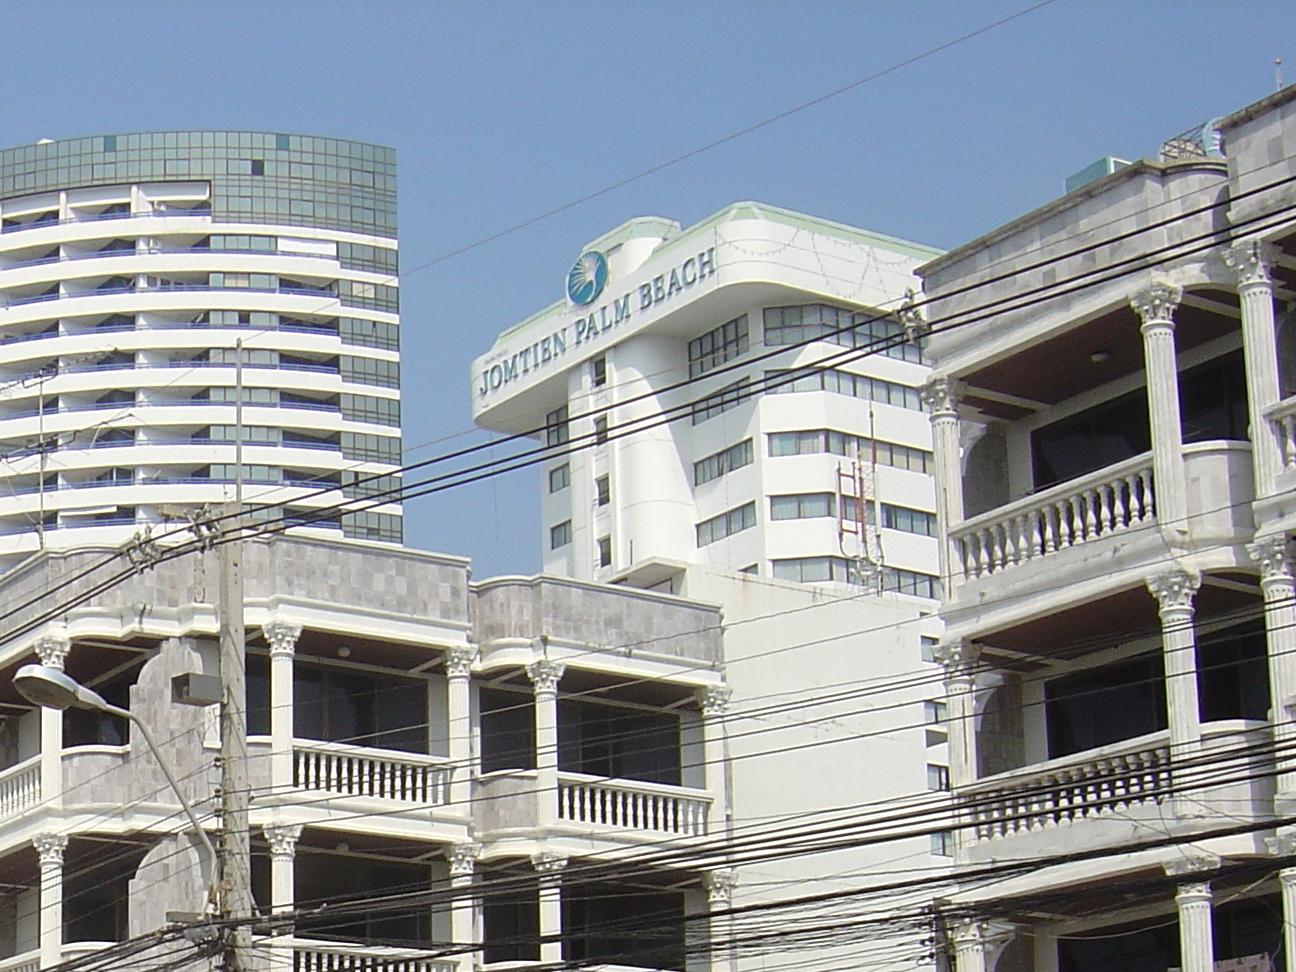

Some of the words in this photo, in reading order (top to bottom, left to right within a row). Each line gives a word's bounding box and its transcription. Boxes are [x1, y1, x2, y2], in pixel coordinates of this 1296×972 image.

[479, 327, 568, 396] JOMTIEN
[575, 293, 632, 345] PALM
[639, 247, 716, 311] BEACH
